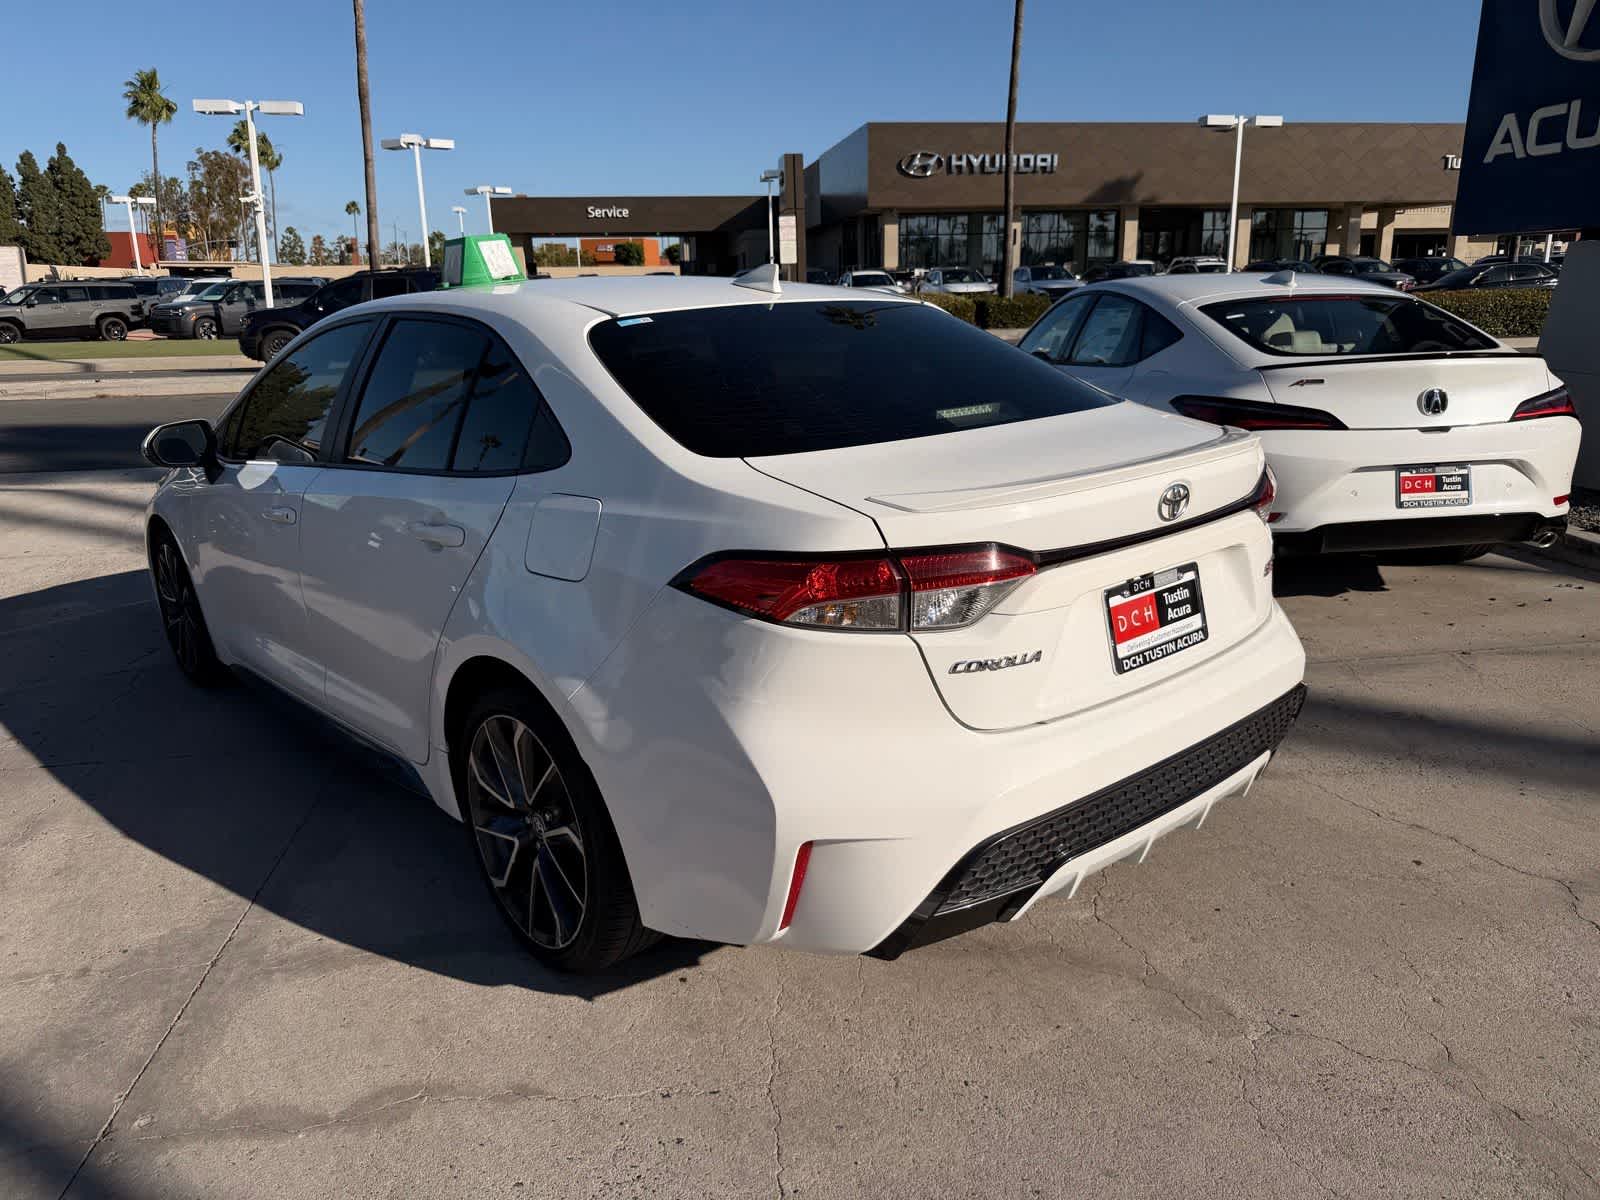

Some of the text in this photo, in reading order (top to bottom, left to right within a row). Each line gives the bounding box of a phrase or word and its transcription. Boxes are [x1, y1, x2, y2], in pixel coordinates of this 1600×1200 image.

[587, 205, 630, 218] Service
[1404, 479, 1432, 490] DCH
[1441, 475, 1462, 483] Tustin
[1133, 579, 1151, 592] DCH
[1163, 587, 1190, 605] Tustin
[1117, 605, 1154, 632] DCH
[1167, 603, 1192, 621] Acura
[1123, 630, 1205, 670] DCH TUSTIN ACURA
[948, 650, 1042, 674] COROLLA
